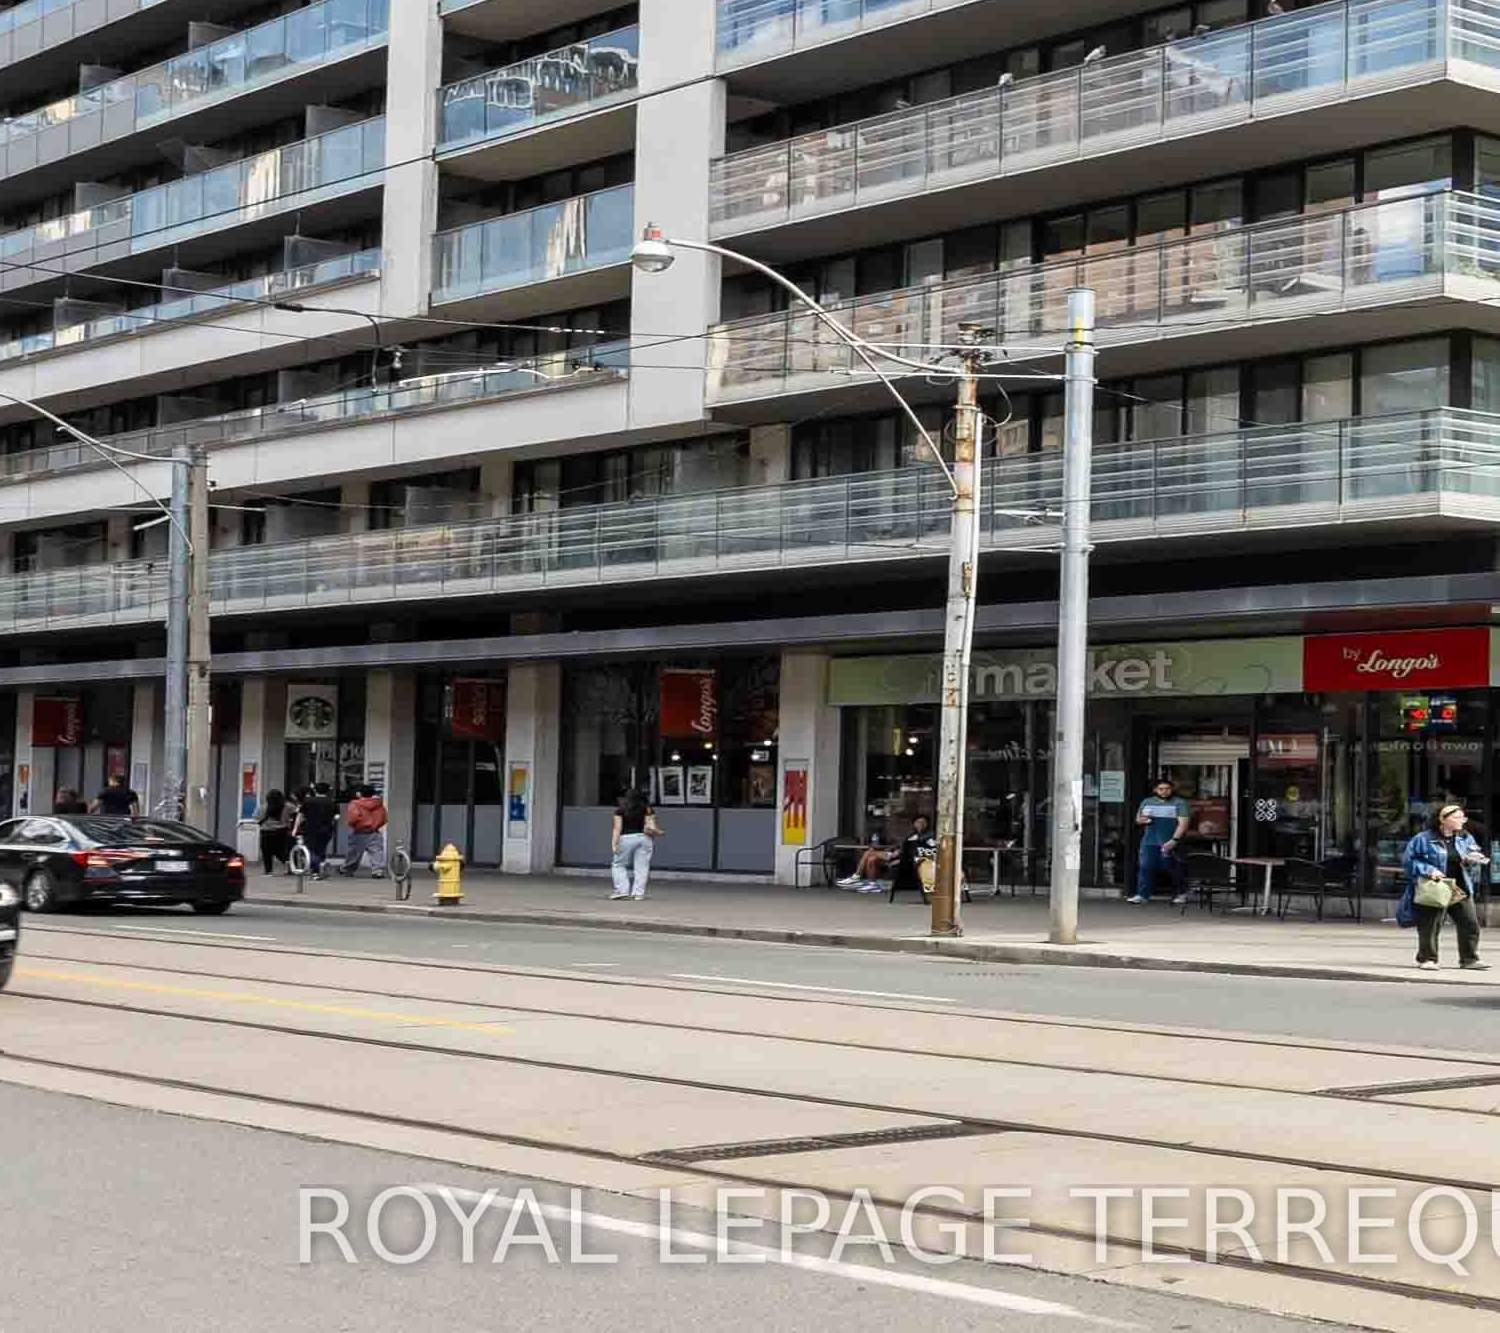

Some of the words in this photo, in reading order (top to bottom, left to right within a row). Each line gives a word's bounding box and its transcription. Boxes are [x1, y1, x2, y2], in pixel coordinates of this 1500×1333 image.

[975, 650, 1173, 694] maket
[1343, 646, 1361, 660] by
[1357, 647, 1443, 678] Longo's
